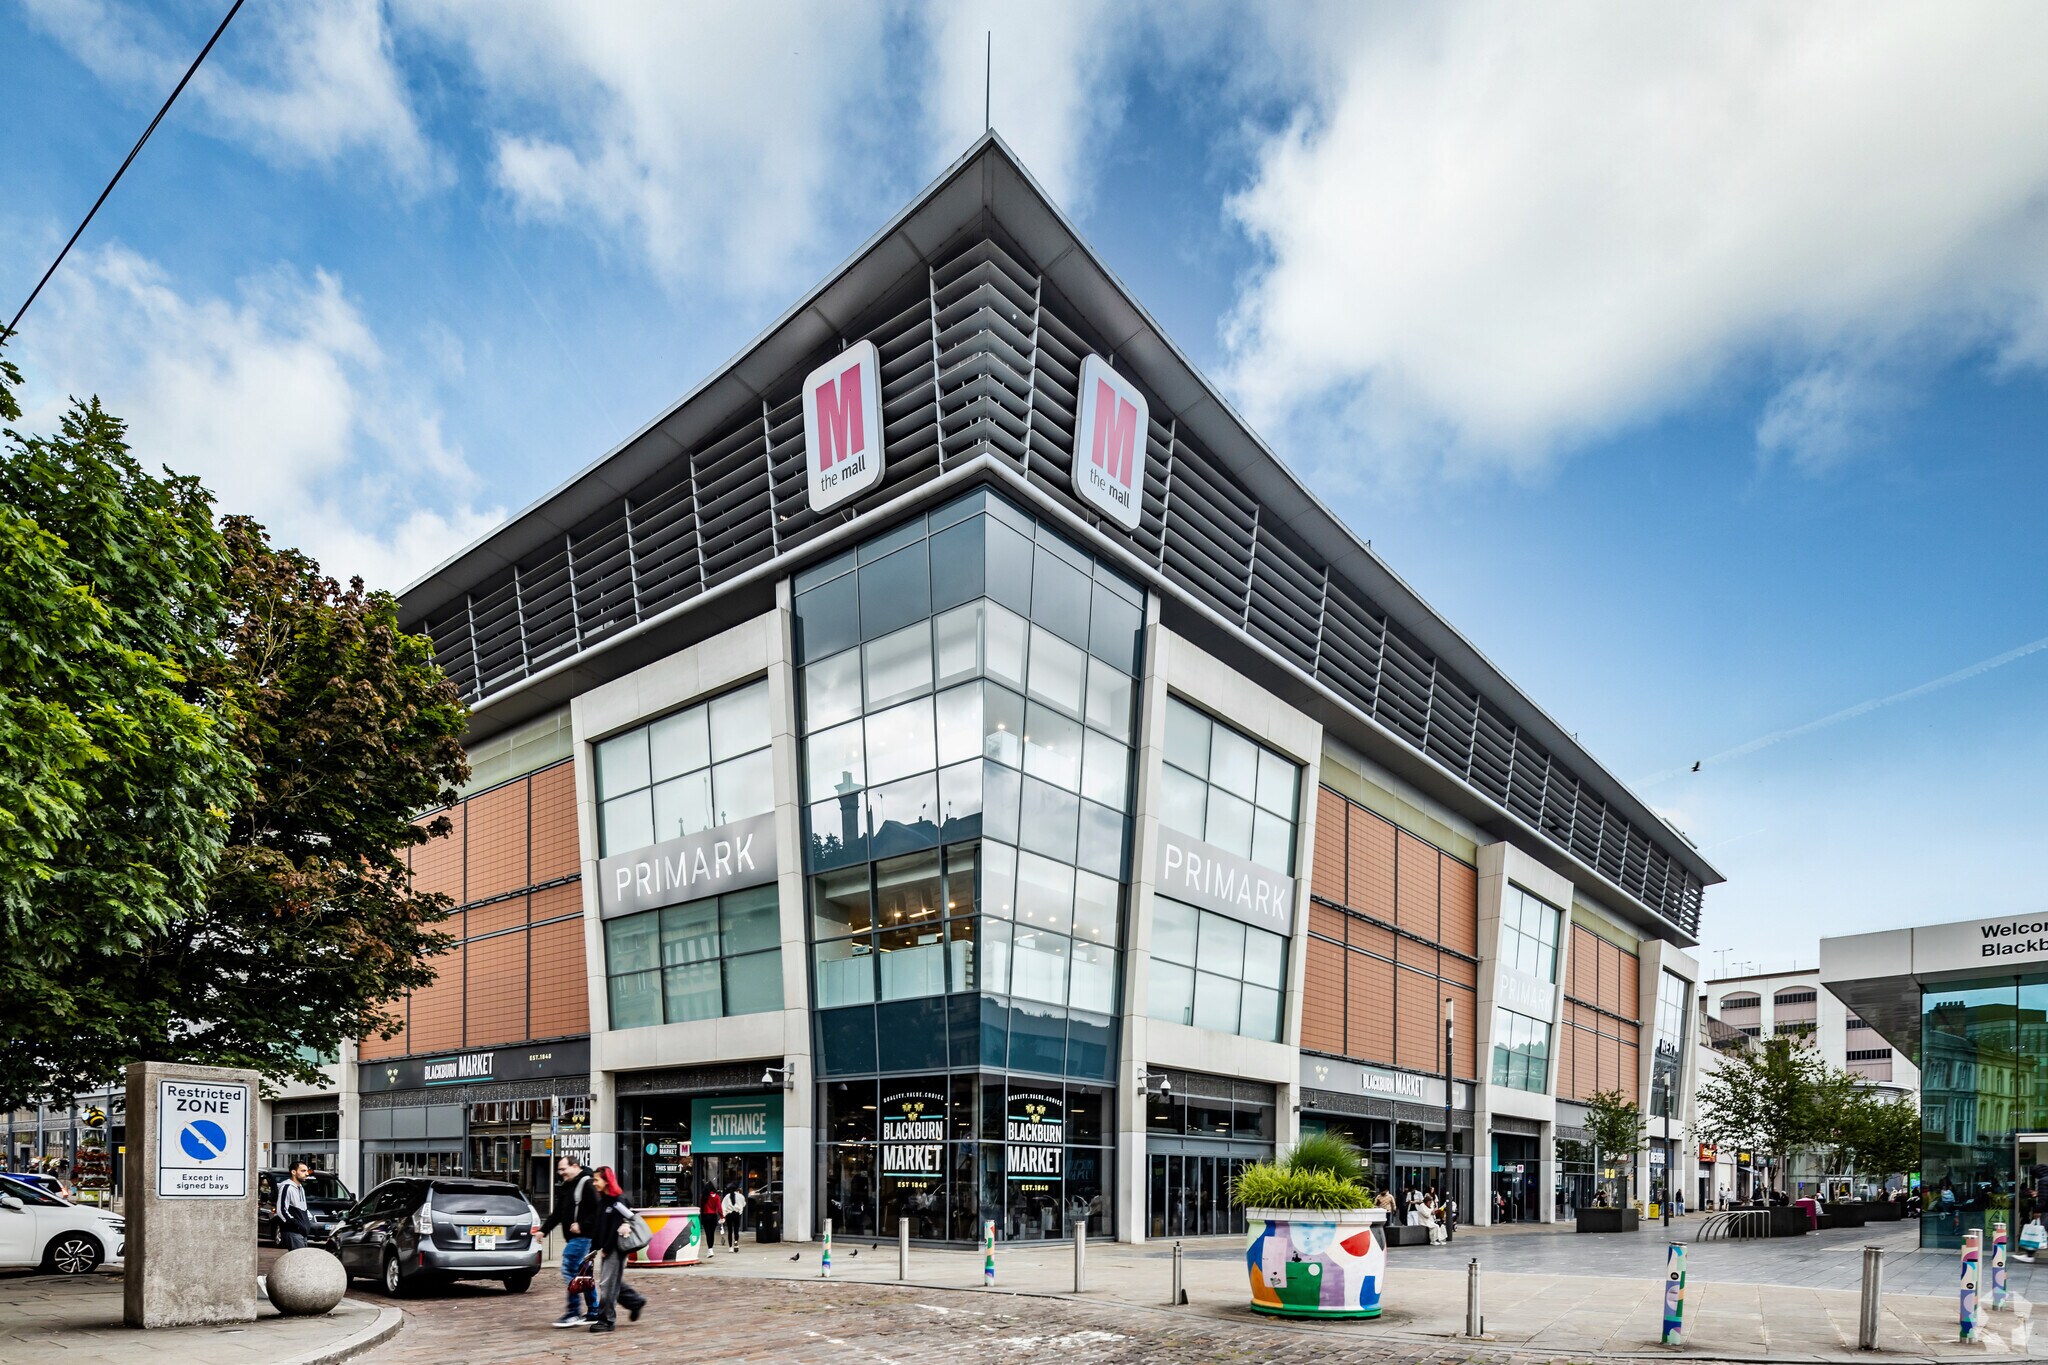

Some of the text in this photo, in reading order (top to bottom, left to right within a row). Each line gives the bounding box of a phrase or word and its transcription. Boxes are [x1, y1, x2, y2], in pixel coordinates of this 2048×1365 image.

[815, 363, 865, 472] M
[1091, 377, 1137, 489] M
[820, 460, 866, 492] the mall
[1090, 468, 1130, 509] the mall
[615, 833, 756, 902] PRIMARK
[1164, 843, 1286, 921] PRIMARK
[1500, 974, 1552, 1013] PRIMARK
[424, 1052, 494, 1080] BLACKBURN MARKET
[167, 1085, 241, 1101] Restricted
[1362, 1073, 1424, 1098] BLACKBURN MARKET
[176, 1099, 230, 1114] ZONE
[710, 1112, 767, 1137] ENTRANCE
[883, 1120, 943, 1140] BLACKBURN
[1007, 1121, 1062, 1143] BLACKBURN
[883, 1144, 943, 1171] MARKET
[1007, 1145, 1062, 1173] MARKET
[182, 1173, 213, 1182] Except
[209, 1183, 229, 1191] bays
